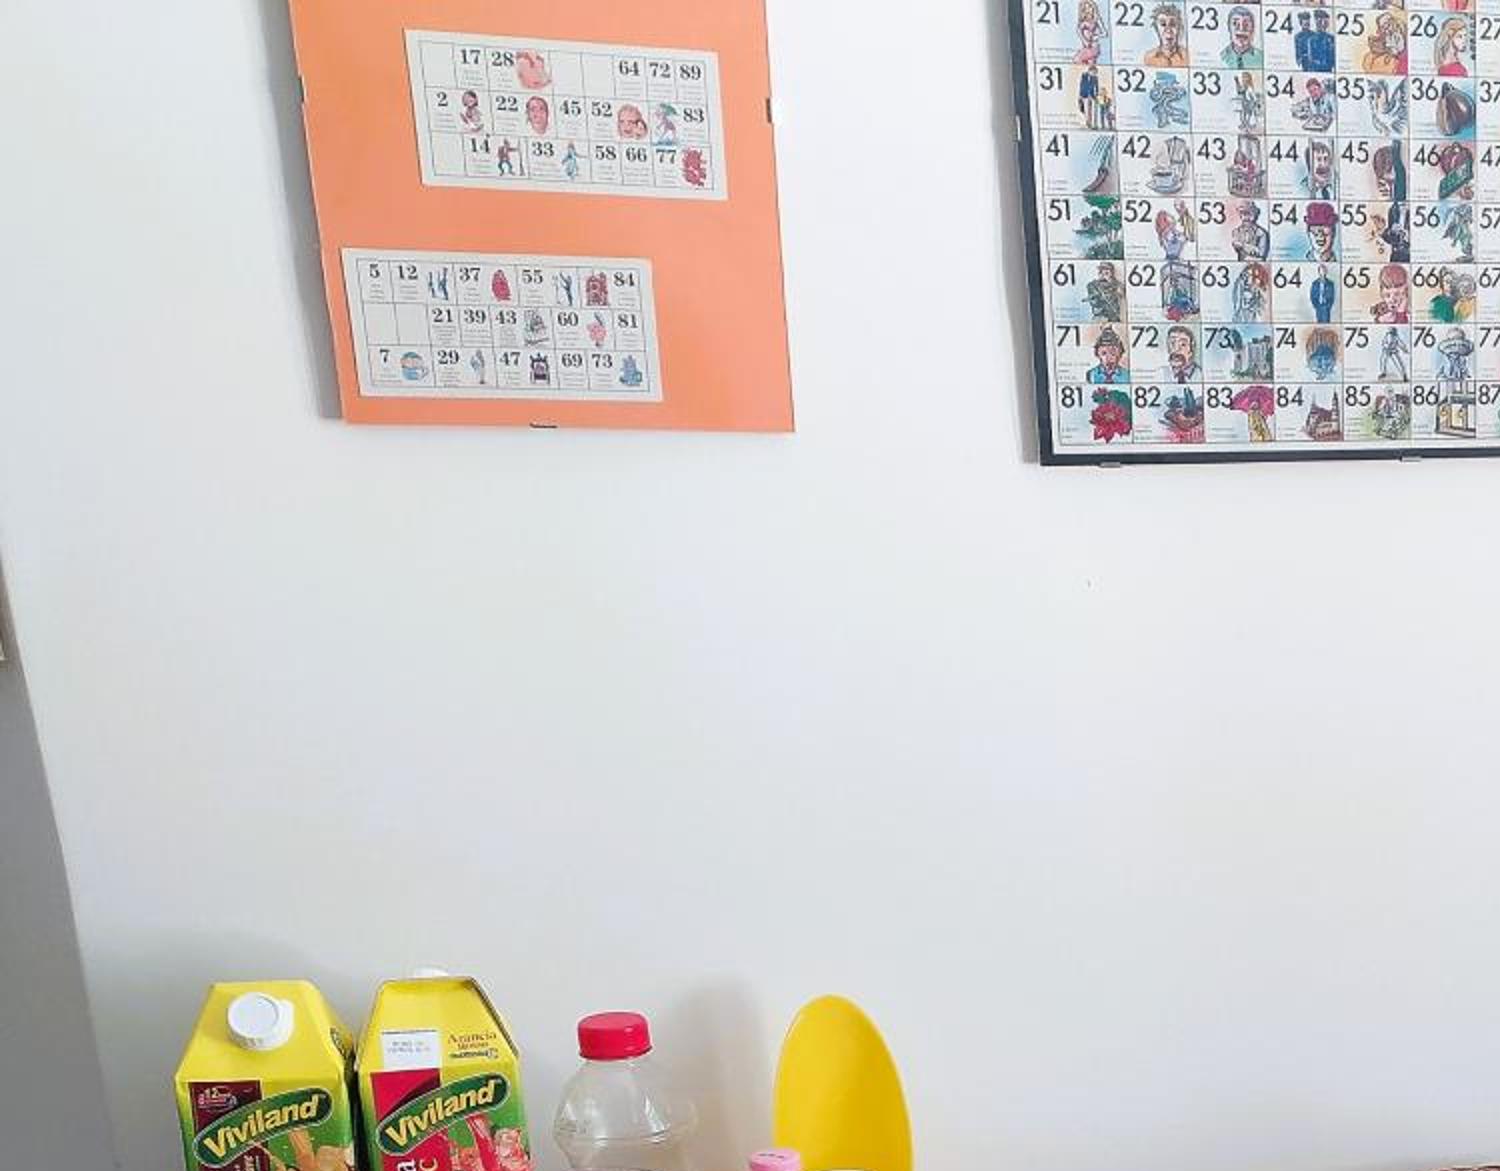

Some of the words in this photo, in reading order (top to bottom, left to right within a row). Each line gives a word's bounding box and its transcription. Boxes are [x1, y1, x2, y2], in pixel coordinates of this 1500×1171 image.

[1038, 2, 1059, 24] 21
[1116, 3, 1144, 27] 22
[1192, 7, 1218, 30] 23
[1266, 10, 1294, 33] 24
[1338, 13, 1364, 36] 25
[1410, 15, 1438, 38] 26
[461, 50, 480, 64] 17
[492, 52, 514, 66] 28
[619, 61, 640, 75] 64
[650, 63, 671, 78] 72
[680, 65, 701, 80] 89
[1040, 67, 1063, 90] 31
[1118, 70, 1146, 92] 32
[1194, 72, 1221, 95] 33
[1267, 75, 1295, 98] 34
[1338, 77, 1364, 99] 35
[1412, 78, 1438, 101] 36
[437, 92, 448, 107] 2
[496, 96, 517, 111] 22
[560, 100, 581, 115] 45
[592, 102, 612, 117] 52
[683, 107, 704, 122] 83
[470, 138, 489, 153] 14
[532, 142, 554, 156] 33
[596, 145, 616, 160] 58
[626, 147, 646, 162] 66
[656, 149, 676, 164] 77
[1046, 134, 1069, 156] 41
[1123, 135, 1150, 158] 42
[1198, 138, 1226, 160] 43
[1270, 140, 1298, 162] 44
[1341, 141, 1368, 163] 45
[1414, 145, 1441, 167] 46
[1048, 199, 1070, 221] 51
[1124, 200, 1151, 223] 52
[1200, 201, 1226, 224] 53
[1270, 202, 1298, 224] 54
[1341, 203, 1367, 226] 55
[1413, 206, 1440, 228] 56
[370, 265, 379, 278] 5
[399, 266, 418, 280] 12
[459, 267, 480, 281] 37
[523, 269, 543, 284] 55
[614, 273, 634, 286] 84
[1054, 264, 1076, 286] 61
[1129, 265, 1156, 287] 62
[1202, 265, 1230, 287] 63
[1274, 266, 1302, 288] 64
[1344, 266, 1370, 288] 65
[1413, 267, 1438, 288] 66
[433, 309, 453, 323] 21
[464, 309, 486, 323] 39
[495, 310, 517, 324] 43
[558, 312, 578, 326] 60
[618, 314, 637, 328] 81
[1057, 326, 1080, 346] 71
[1132, 327, 1158, 347] 72
[1205, 328, 1231, 348] 73
[1276, 328, 1297, 348] 74
[1345, 328, 1368, 348] 75
[1414, 326, 1436, 347] 76
[380, 349, 389, 363] 7
[438, 350, 459, 364] 29
[500, 352, 520, 366] 47
[562, 353, 582, 367] 69
[592, 354, 612, 368] 73
[1062, 387, 1083, 407] 81
[1135, 388, 1161, 408] 82
[1208, 388, 1232, 408] 83
[1277, 387, 1303, 408] 84
[1346, 387, 1371, 407] 85
[1413, 385, 1438, 405] 86
[1480, 385, 1500, 404] 87
[203, 1094, 319, 1158] Viviland
[385, 1080, 497, 1147] Viviland
